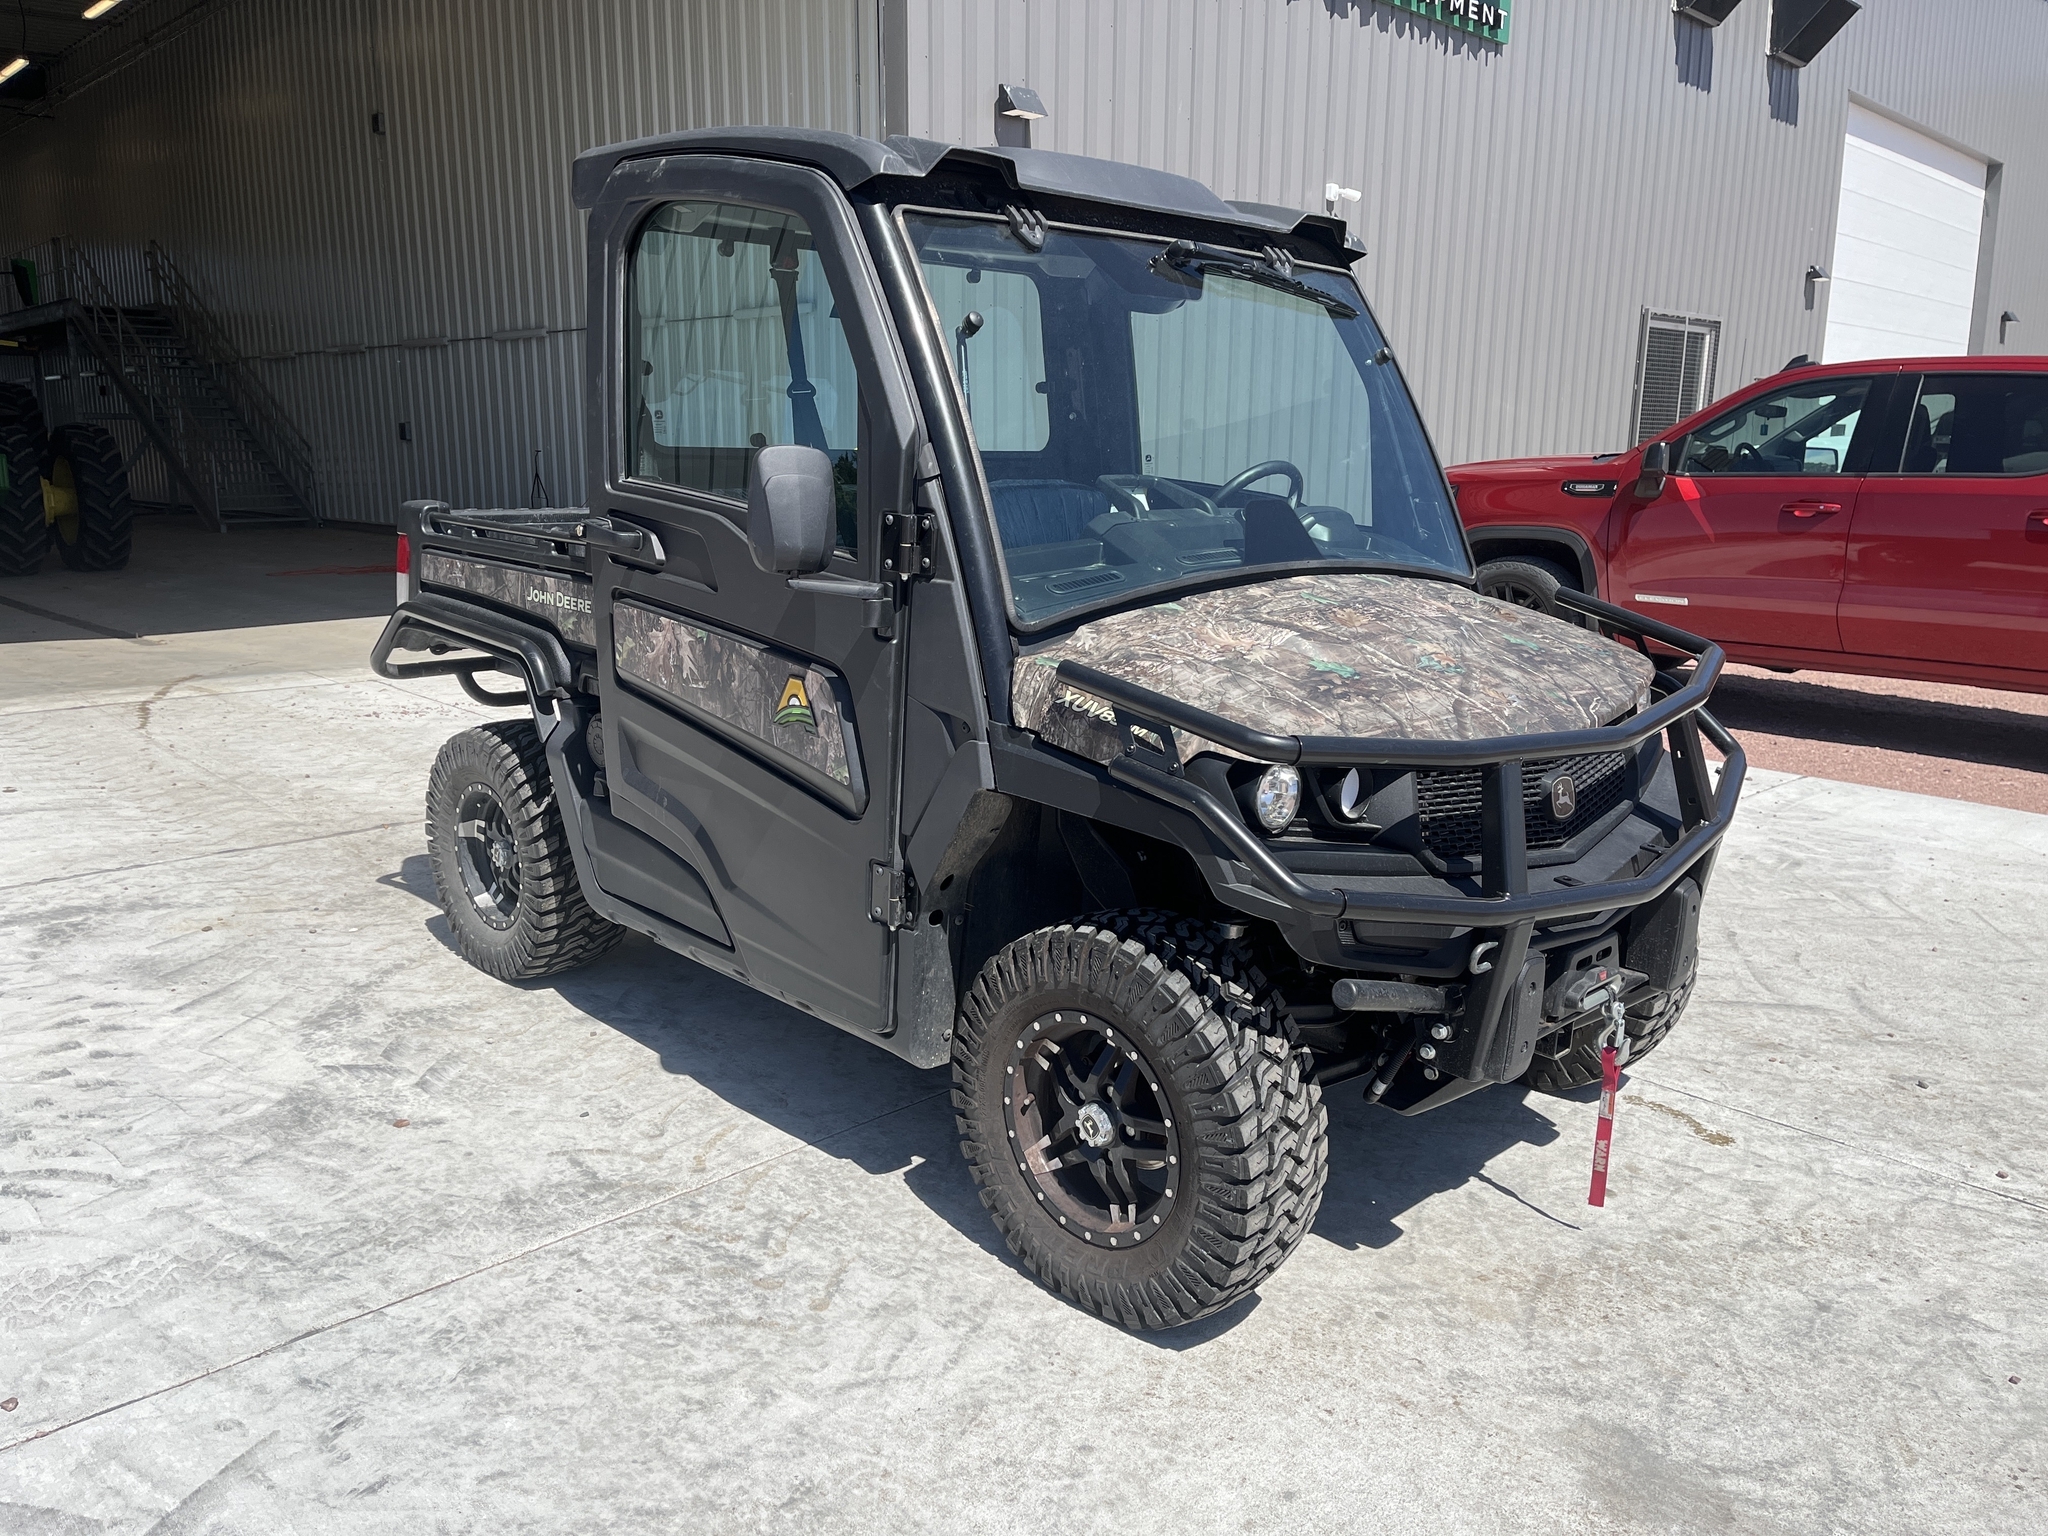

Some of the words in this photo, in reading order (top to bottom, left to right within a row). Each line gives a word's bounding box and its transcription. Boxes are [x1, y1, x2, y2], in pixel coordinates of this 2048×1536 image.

[1426, 0, 1508, 30] MENT
[526, 586, 554, 606] JOHN
[556, 591, 592, 614] DEERE
[1594, 1139, 1608, 1173] WARN
